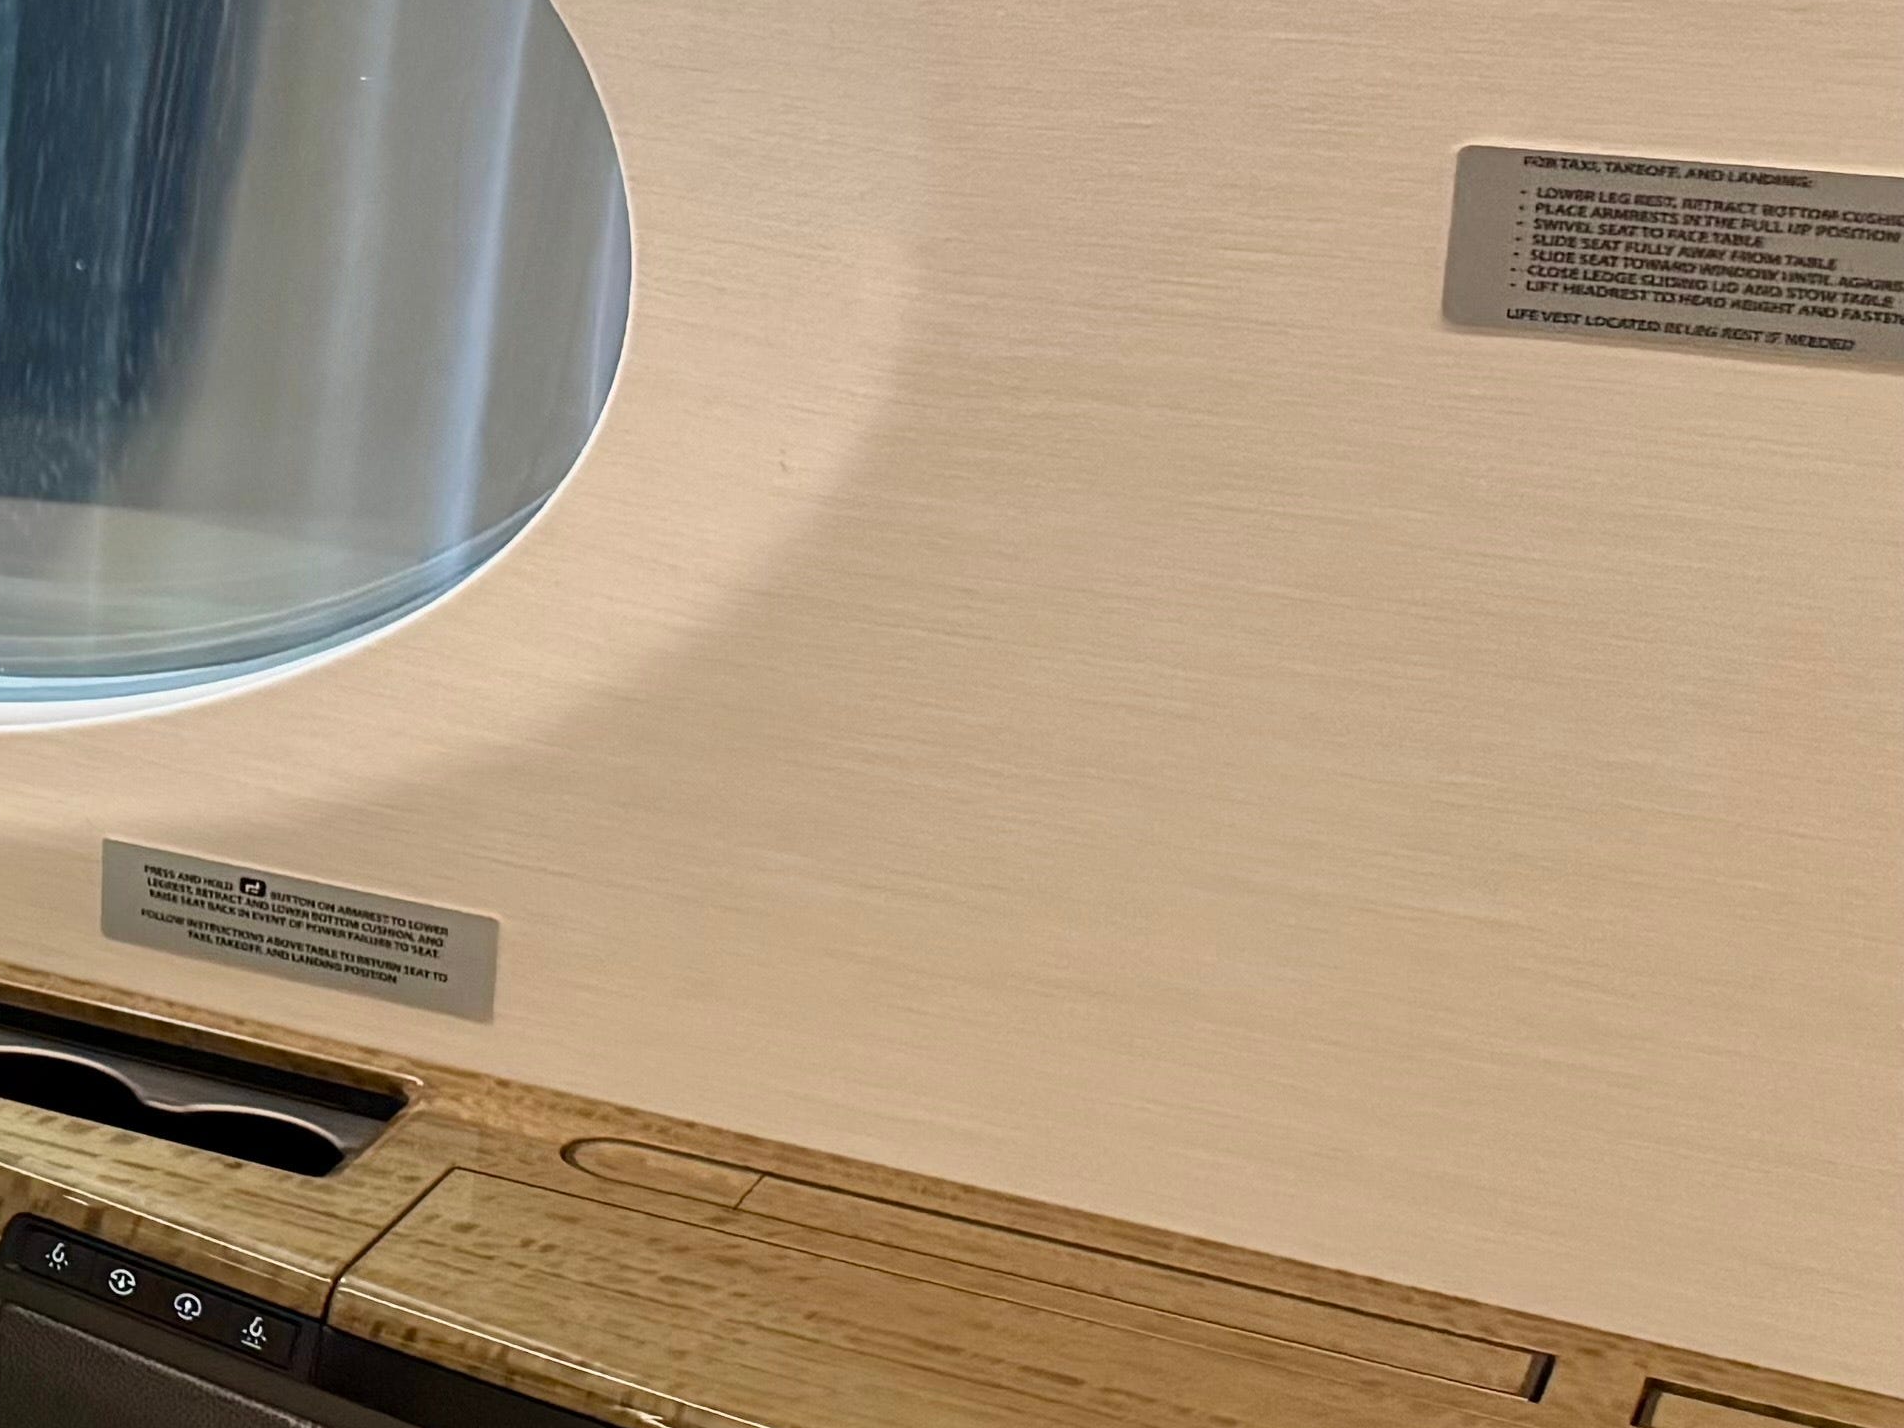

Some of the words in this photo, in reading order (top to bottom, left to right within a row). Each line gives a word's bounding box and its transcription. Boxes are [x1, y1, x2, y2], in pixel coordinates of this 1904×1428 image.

[1685, 167, 1724, 181] AND
[1537, 188, 1595, 202] LOWER
[1599, 192, 1631, 204] LEG
[1533, 218, 1592, 234] SWIVEL
[1598, 223, 1639, 237] SEAT
[1641, 227, 1663, 239] TO
[1667, 229, 1708, 243] FACE
[1712, 232, 1764, 247] TABLE
[1535, 203, 1587, 217] PLACE
[1590, 207, 1678, 224] ARMRESTS
[1701, 216, 1737, 229] THE
[1742, 219, 1783, 232] FULL
[1815, 225, 1901, 241] POSITION
[1530, 249, 1576, 264] SLIDE
[1579, 253, 1618, 268] SEAT
[1532, 234, 1577, 248] SLIDE
[1580, 238, 1622, 252] SEAT
[1624, 241, 1675, 256] FULLY
[1731, 250, 1781, 265] FROM
[1784, 254, 1838, 270] TABLE
[1526, 280, 1559, 293] LIFT
[1563, 284, 1648, 301] HEADREST
[1679, 294, 1726, 308] HEAD
[1798, 304, 1838, 318] AND
[1527, 265, 1579, 280] CLOSE
[1583, 269, 1637, 285] LEDGE
[1743, 283, 1782, 297] AND
[1787, 287, 1837, 302] STOW
[1507, 308, 1539, 321] LIFE
[1542, 311, 1582, 325] VEST
[1585, 315, 1661, 332] LOCATED
[208, 902, 236, 914] BACK
[252, 911, 286, 925] EVENT
[289, 919, 305, 929] OF
[306, 923, 346, 937] POWER
[394, 941, 408, 951] TO
[245, 898, 269, 909] AND
[311, 911, 359, 928] BOTTOM
[418, 934, 443, 946] AND
[392, 917, 406, 927] TO
[142, 908, 184, 924] FOLLOW
[267, 935, 305, 950] ABOVE
[306, 944, 337, 957] TABLE
[404, 965, 431, 978] SEAT
[434, 972, 448, 981] TO
[266, 947, 290, 959] AND
